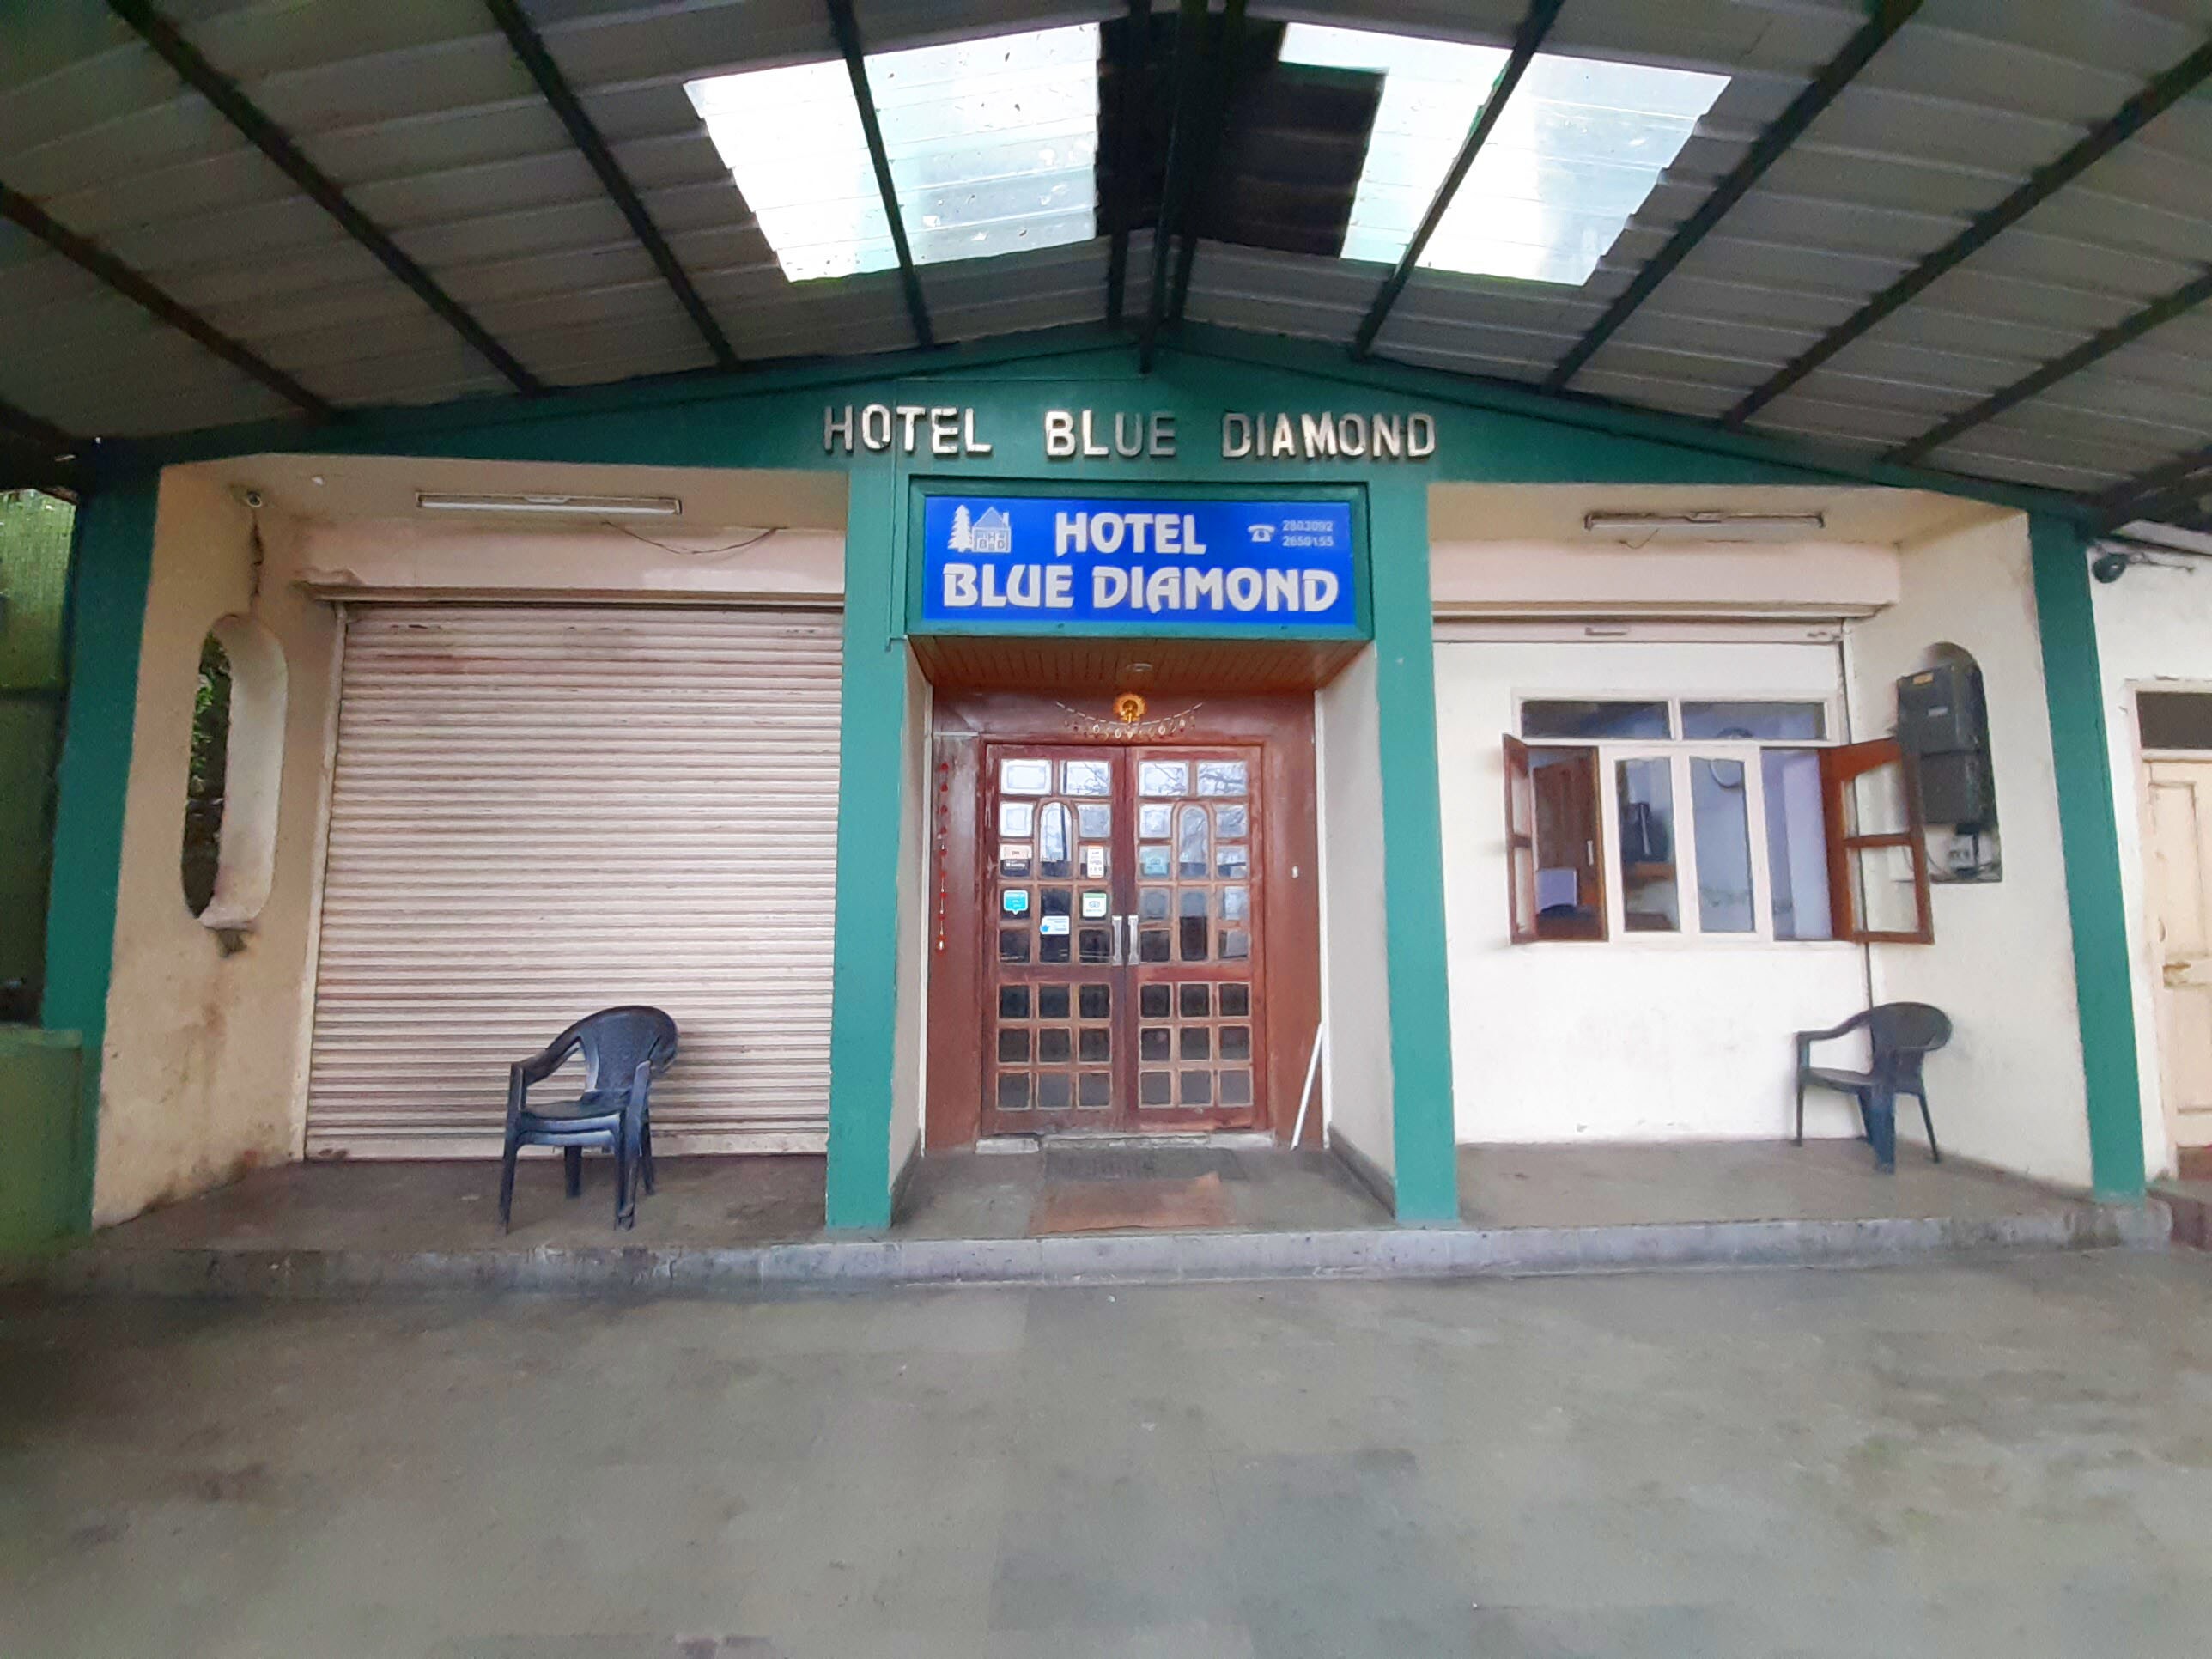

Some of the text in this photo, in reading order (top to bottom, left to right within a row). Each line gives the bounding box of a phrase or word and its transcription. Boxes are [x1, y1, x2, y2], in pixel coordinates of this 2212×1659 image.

[823, 404, 1436, 459] HOTEL BLUE DIAMOND
[1055, 513, 1206, 557] HOTEL
[943, 563, 1339, 613] BLUE DIAMOND
